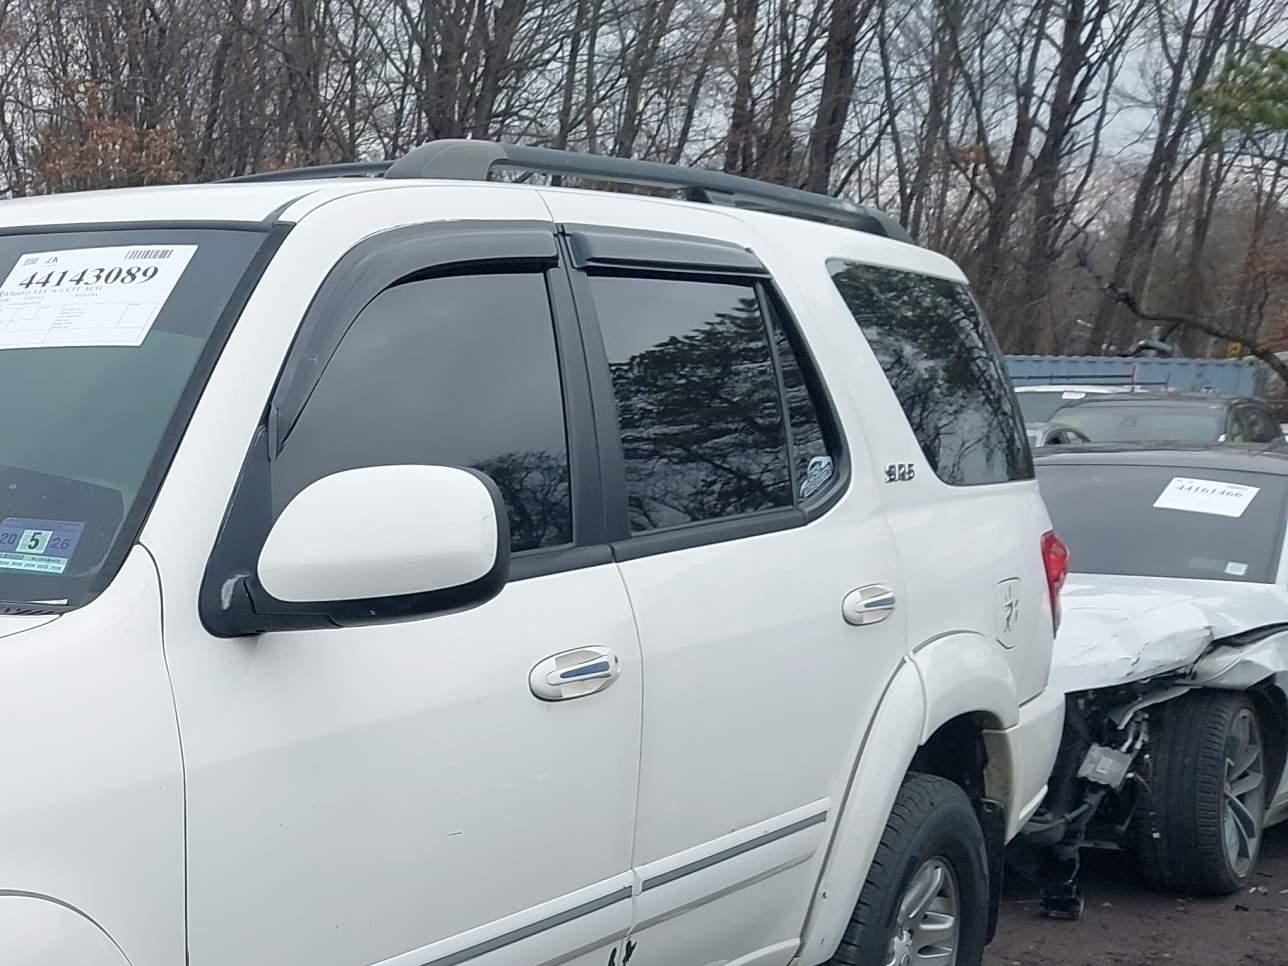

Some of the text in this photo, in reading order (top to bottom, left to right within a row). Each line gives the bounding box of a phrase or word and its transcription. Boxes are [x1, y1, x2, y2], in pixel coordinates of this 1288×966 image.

[19, 266, 159, 289] 44143089
[0, 532, 71, 550] 20 5 26
